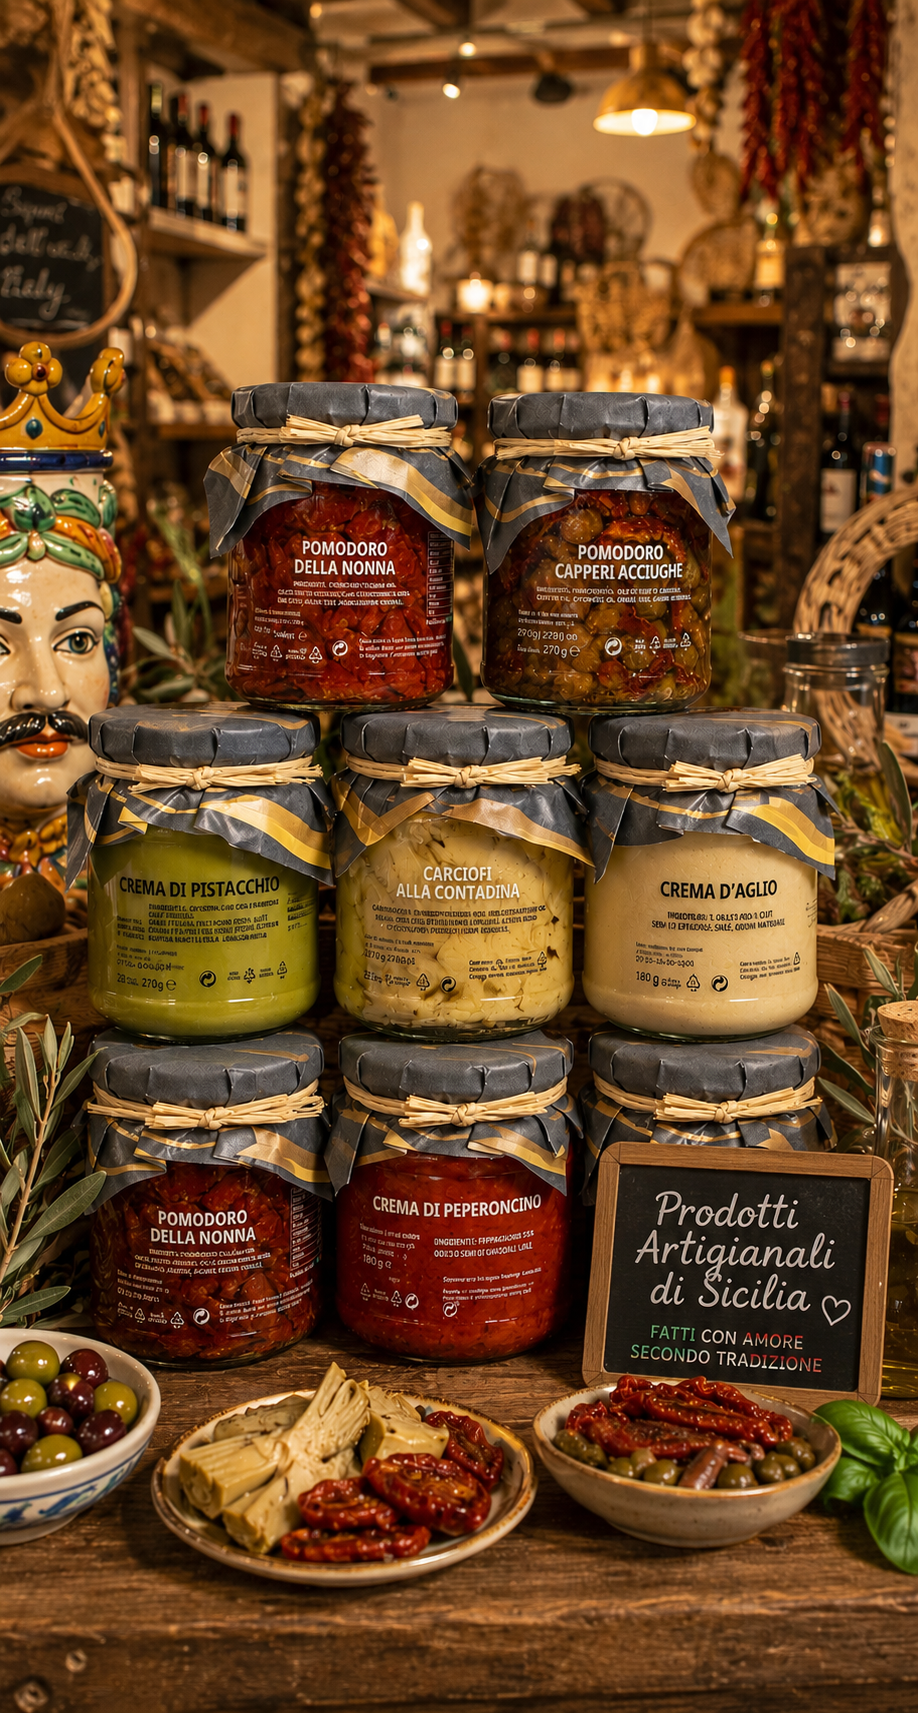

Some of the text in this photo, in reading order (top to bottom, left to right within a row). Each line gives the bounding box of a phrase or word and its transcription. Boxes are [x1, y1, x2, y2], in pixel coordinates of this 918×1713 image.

[302, 540, 388, 557] POMODORO
[578, 544, 664, 561] POMODORO
[294, 559, 396, 576] DELLA NONNA
[555, 563, 683, 580] CAPPERI ACCIUGHE
[423, 866, 492, 881] CARCIOFI
[119, 875, 280, 898] CREMA DI PISTACCHIO
[396, 883, 520, 900] ALLA CONTADINA
[660, 881, 715, 899] CREMA
[372, 1194, 542, 1218] CREMA DI PEPERONCINO
[655, 1190, 799, 1229] Prodotti
[158, 1209, 247, 1227] POMODORO
[150, 1226, 256, 1245] DELLA NONNA
[634, 1229, 836, 1281] Artigianali
[650, 1271, 811, 1312] di Sicilia
[650, 1324, 804, 1350] FATTI CON AMORE
[630, 1344, 823, 1373] SECONDO TRADIZIONE
